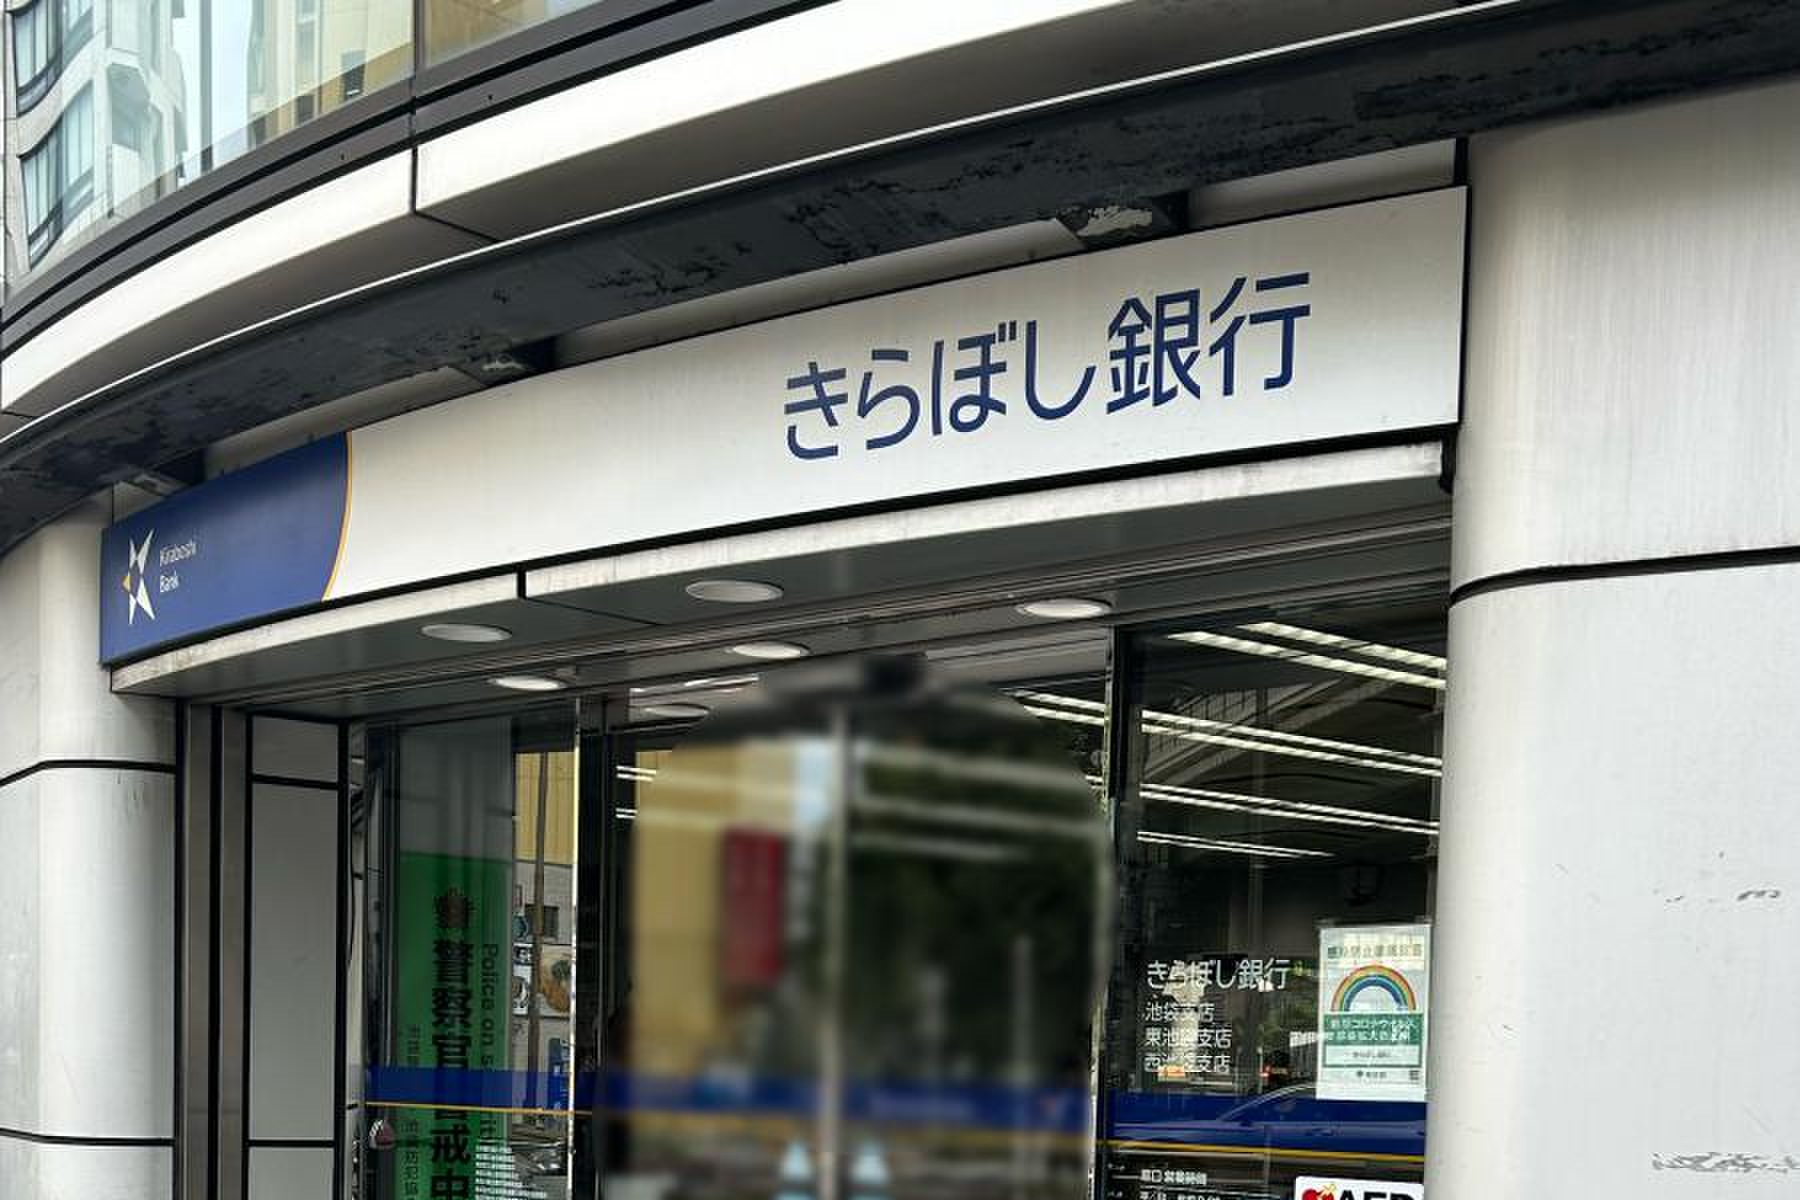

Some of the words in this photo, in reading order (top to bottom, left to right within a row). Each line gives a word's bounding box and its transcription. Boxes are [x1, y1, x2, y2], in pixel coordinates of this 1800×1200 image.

[785, 272, 1311, 460] きらぼし銀行
[480, 944, 497, 1010] Police
[1147, 958, 1290, 990] きらぼし銀行
[481, 1021, 495, 1046] on
